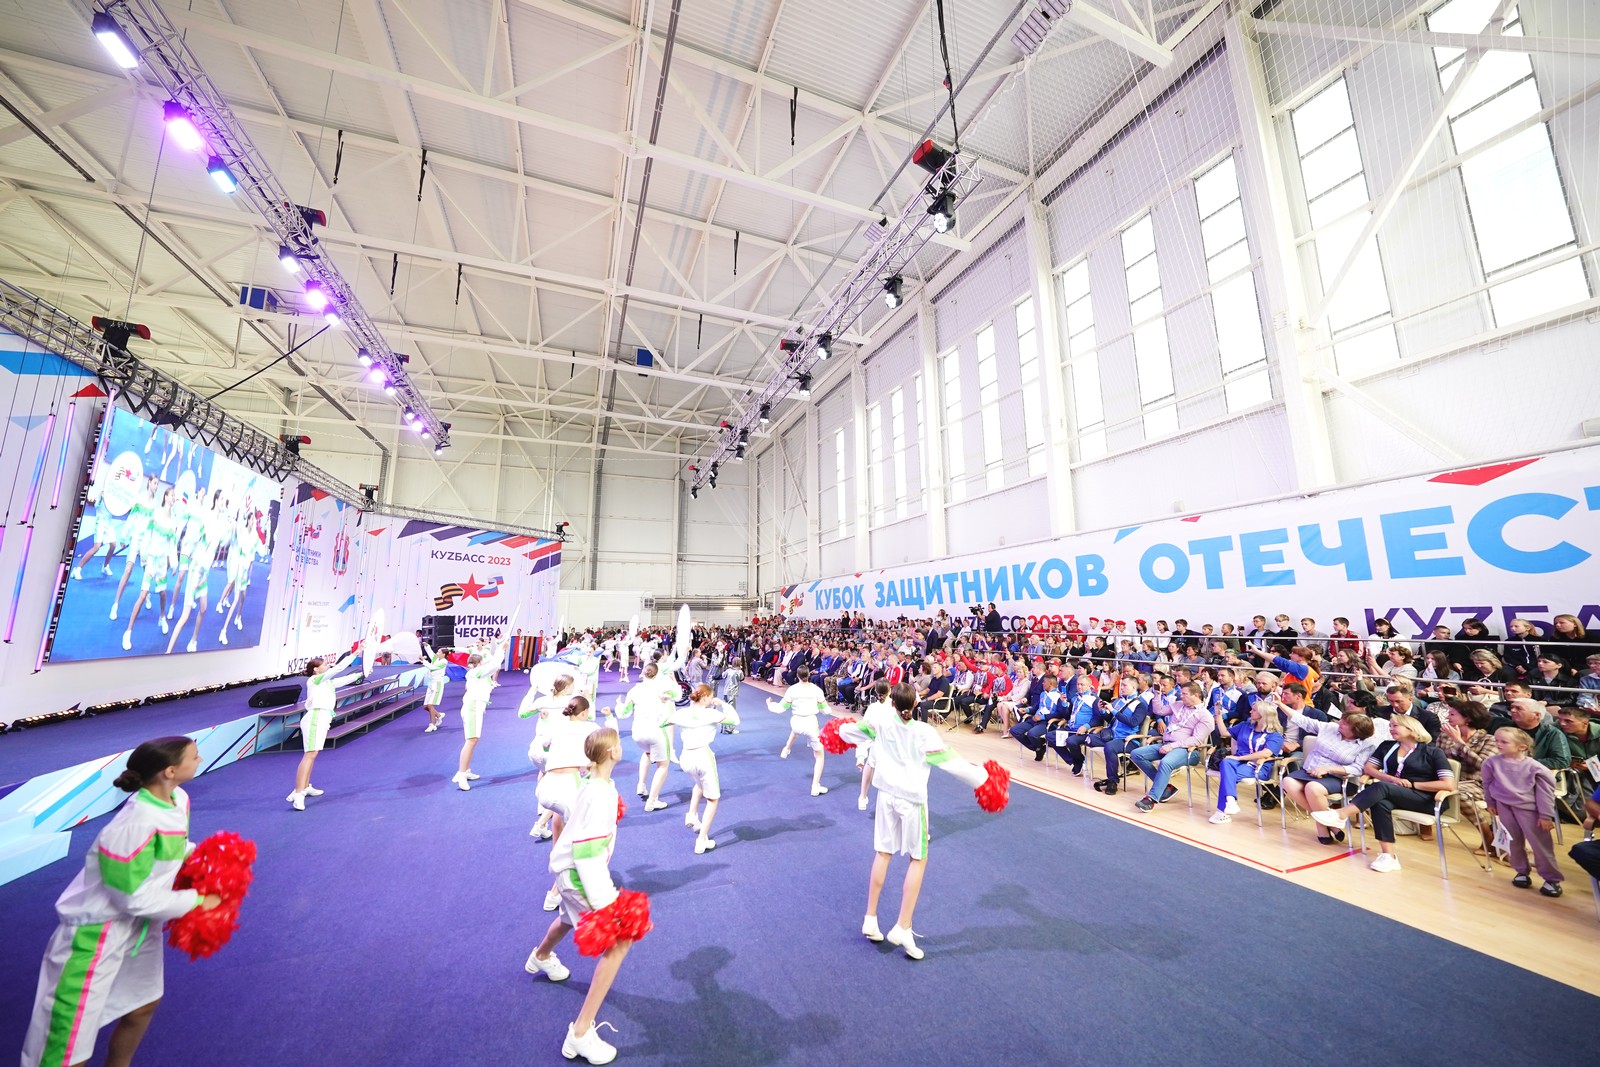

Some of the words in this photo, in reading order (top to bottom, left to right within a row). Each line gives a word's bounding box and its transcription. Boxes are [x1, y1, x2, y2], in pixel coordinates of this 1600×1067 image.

[431, 550, 485, 563] КУZБАСС
[487, 556, 511, 566] 2023
[815, 584, 866, 610] КУБОК
[874, 553, 1110, 611] ЗАЩИТНИКОВ
[1139, 486, 1600, 594] ОТЕЧЕС
